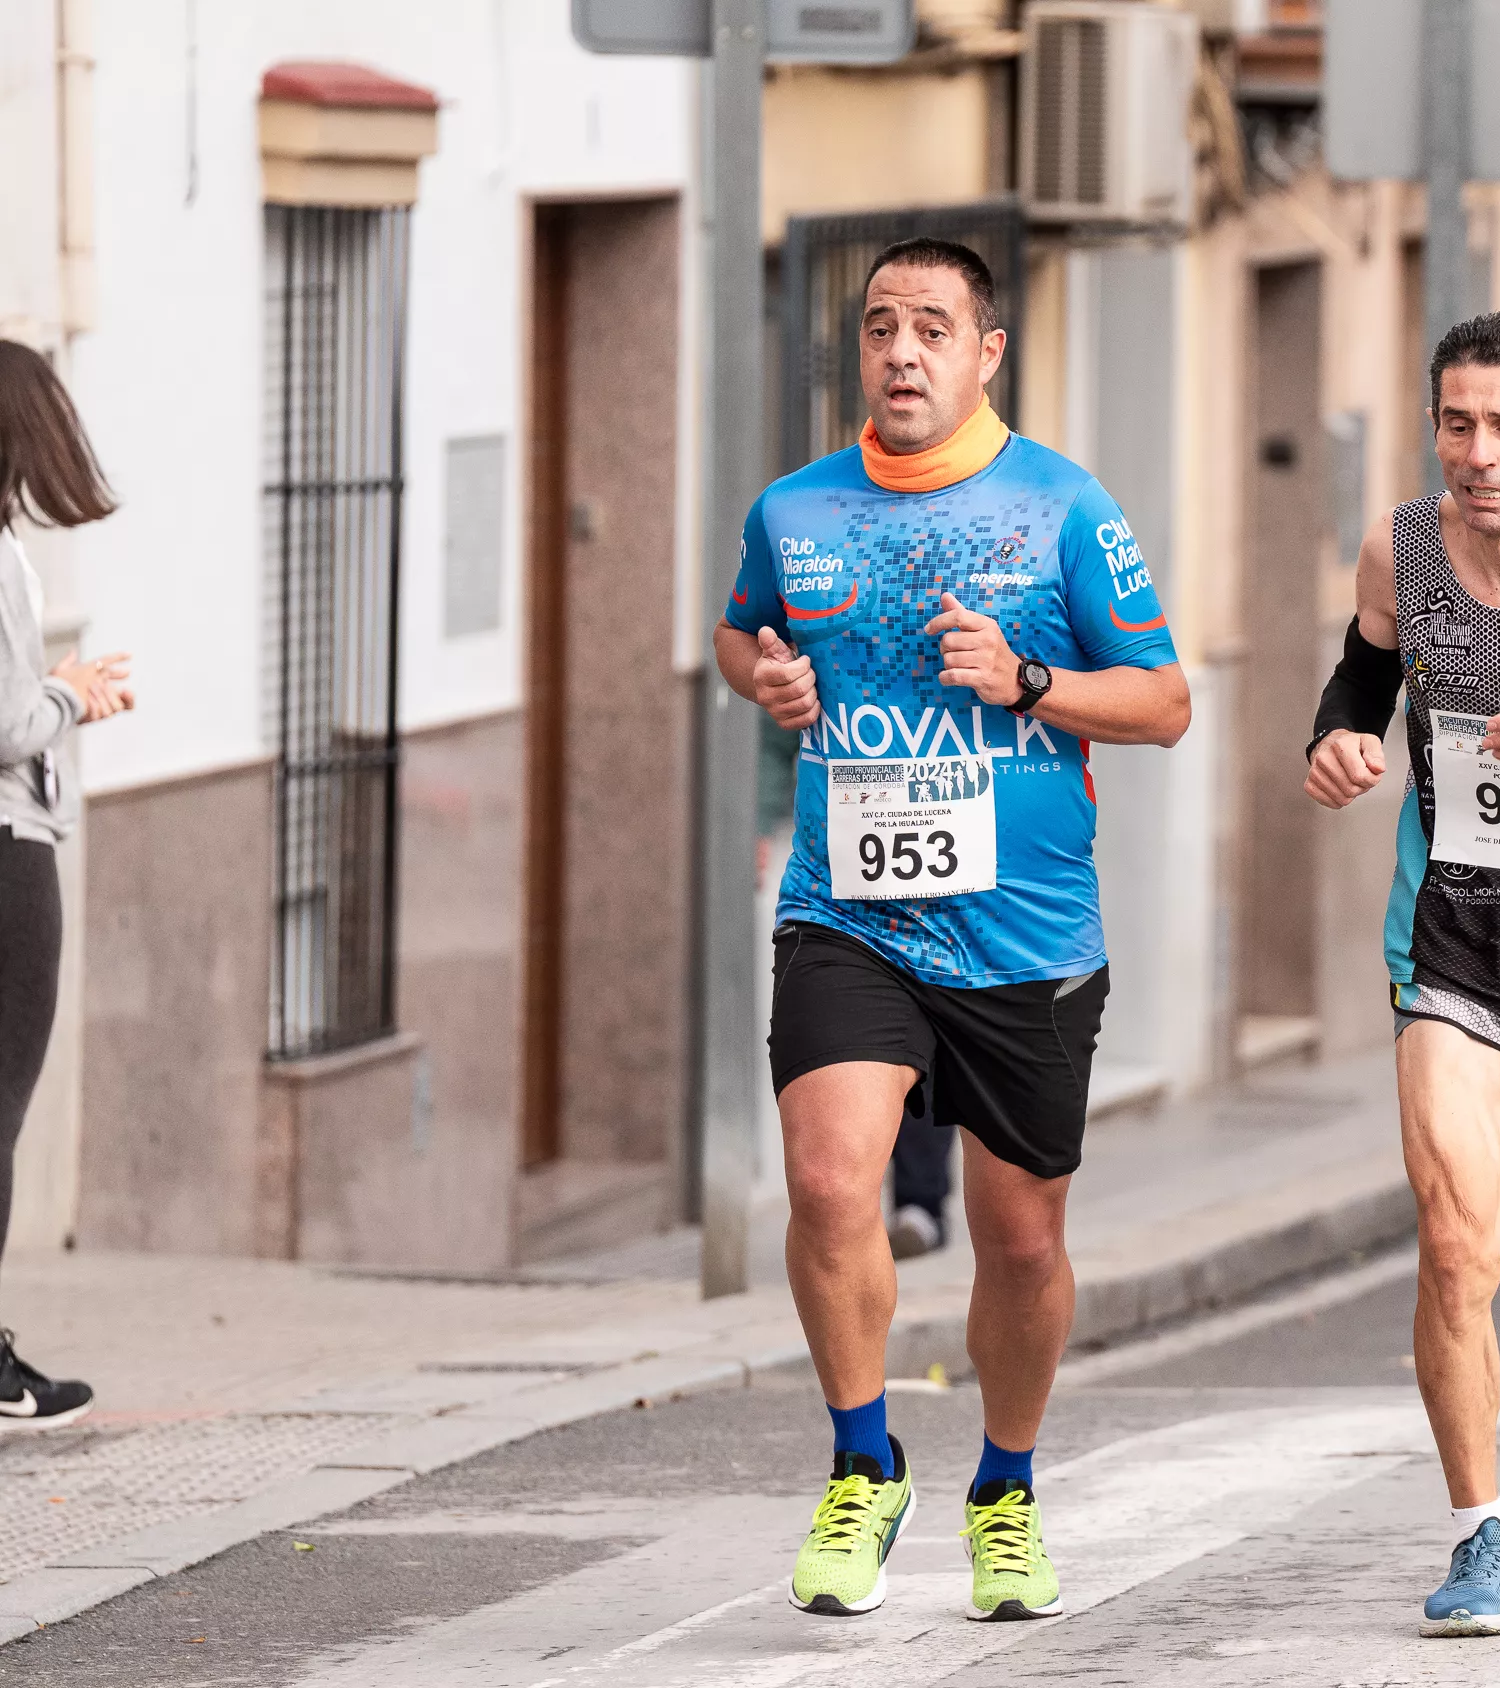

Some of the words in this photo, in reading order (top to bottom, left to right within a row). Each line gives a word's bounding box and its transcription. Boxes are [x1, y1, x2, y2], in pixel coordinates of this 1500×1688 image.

[1096, 515, 1134, 550] Clu
[779, 537, 816, 556] Club
[782, 553, 844, 575] Maratón
[784, 575, 834, 594] Lucena
[968, 572, 1035, 587] enerplus
[1429, 623, 1471, 637] ATLETISMO
[1431, 646, 1467, 656] LUCENA
[1429, 681, 1474, 694] Lucena
[1437, 716, 1470, 728] CIRCUITO
[1438, 723, 1478, 735] CARRERAS
[831, 766, 854, 775] CIRCUITO
[854, 765, 893, 775] PROVINCIAL
[895, 764, 905, 774] DE
[906, 762, 954, 782] 2024
[831, 774, 861, 784] CARRERAS
[862, 773, 905, 783] POPULARES
[924, 808, 952, 816] LUCENA
[898, 819, 935, 827] IGUALDAD
[1474, 836, 1492, 844] JOSE
[858, 830, 958, 882] 953
